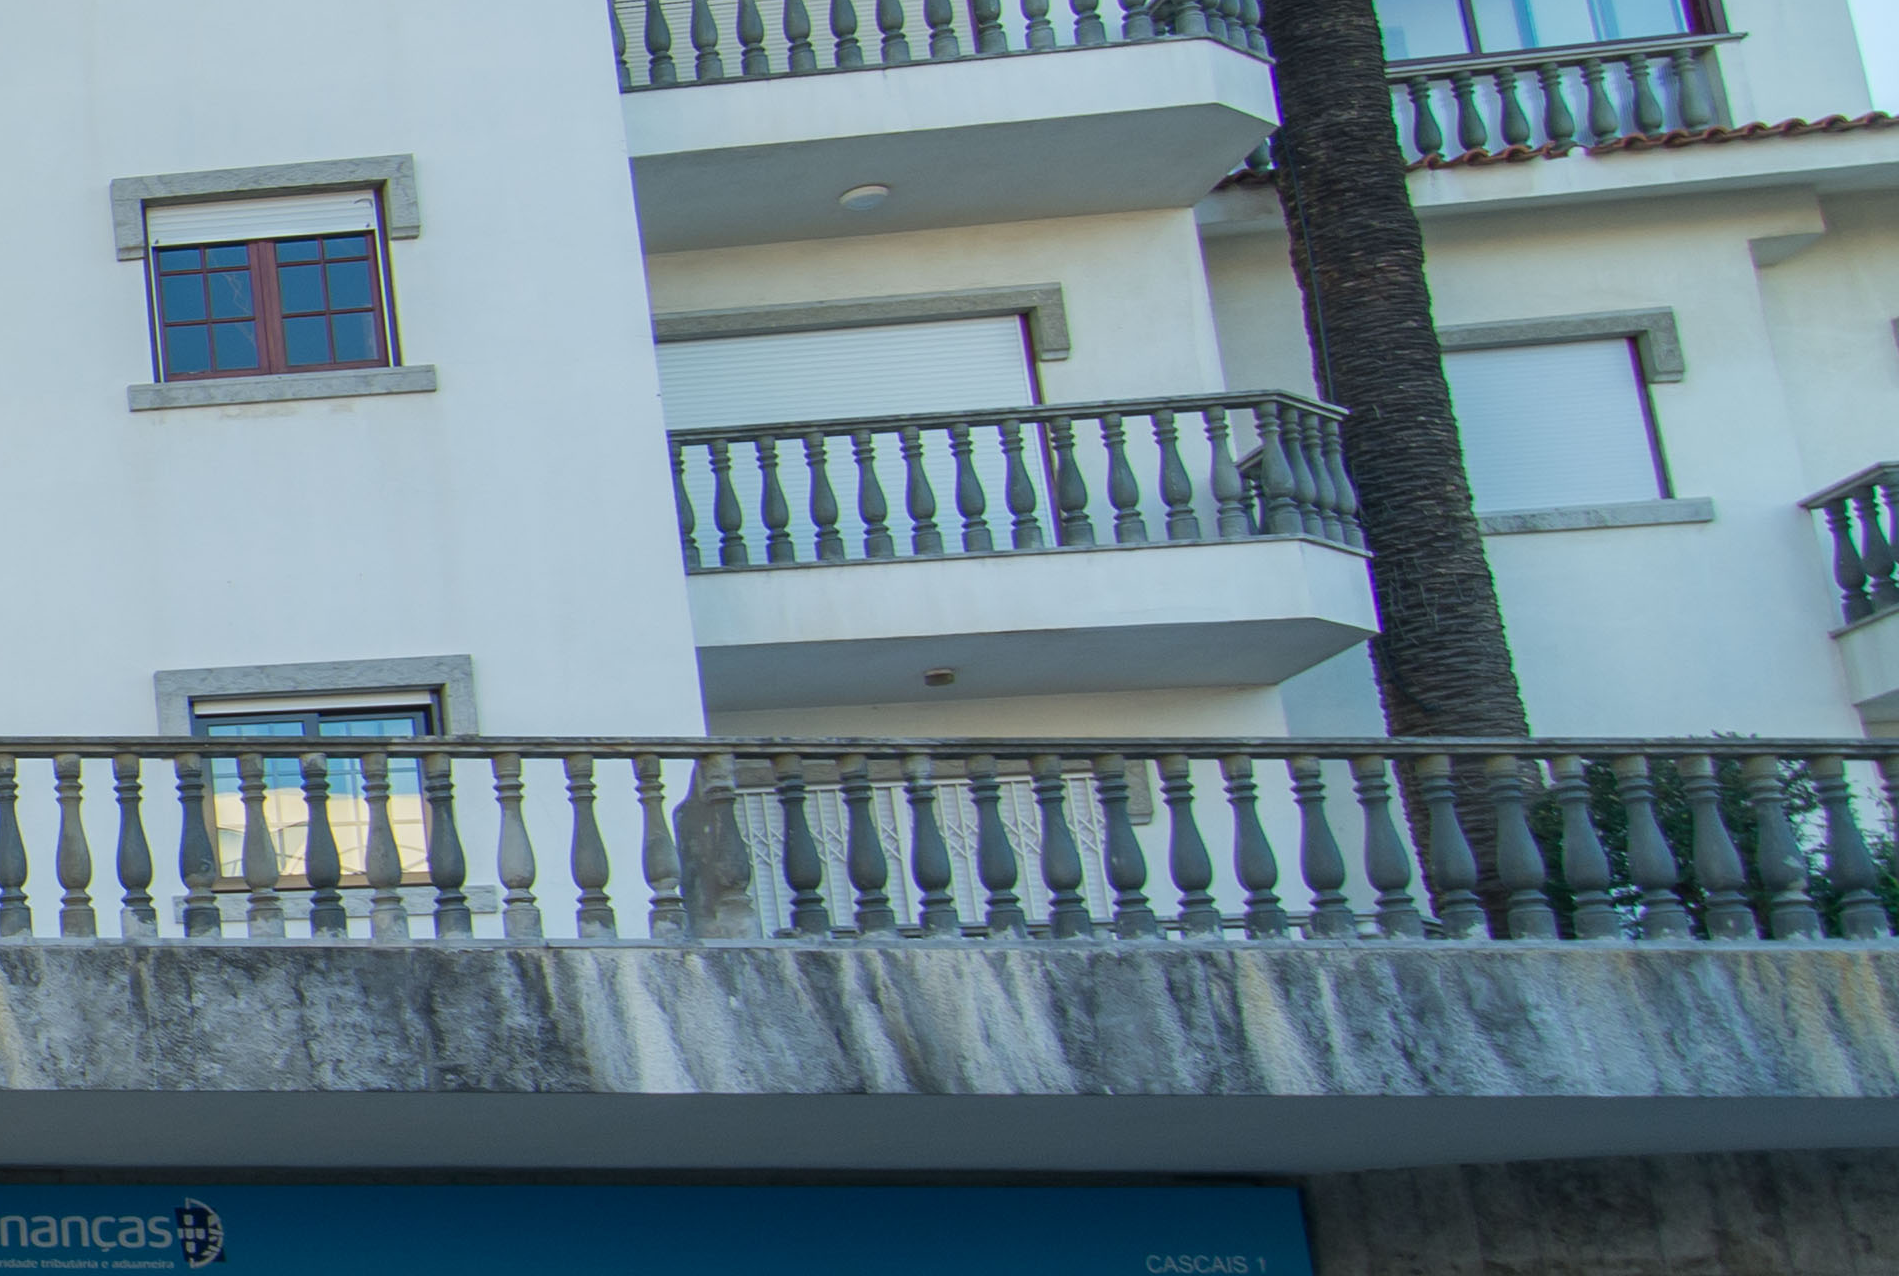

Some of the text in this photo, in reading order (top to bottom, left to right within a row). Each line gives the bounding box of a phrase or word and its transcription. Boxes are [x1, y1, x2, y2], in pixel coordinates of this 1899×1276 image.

[40, 1258, 99, 1269] tributária
[101, 1260, 109, 1269] e
[111, 1259, 175, 1270] aduaneira
[1146, 1254, 1266, 1274] CASCAIS 1
